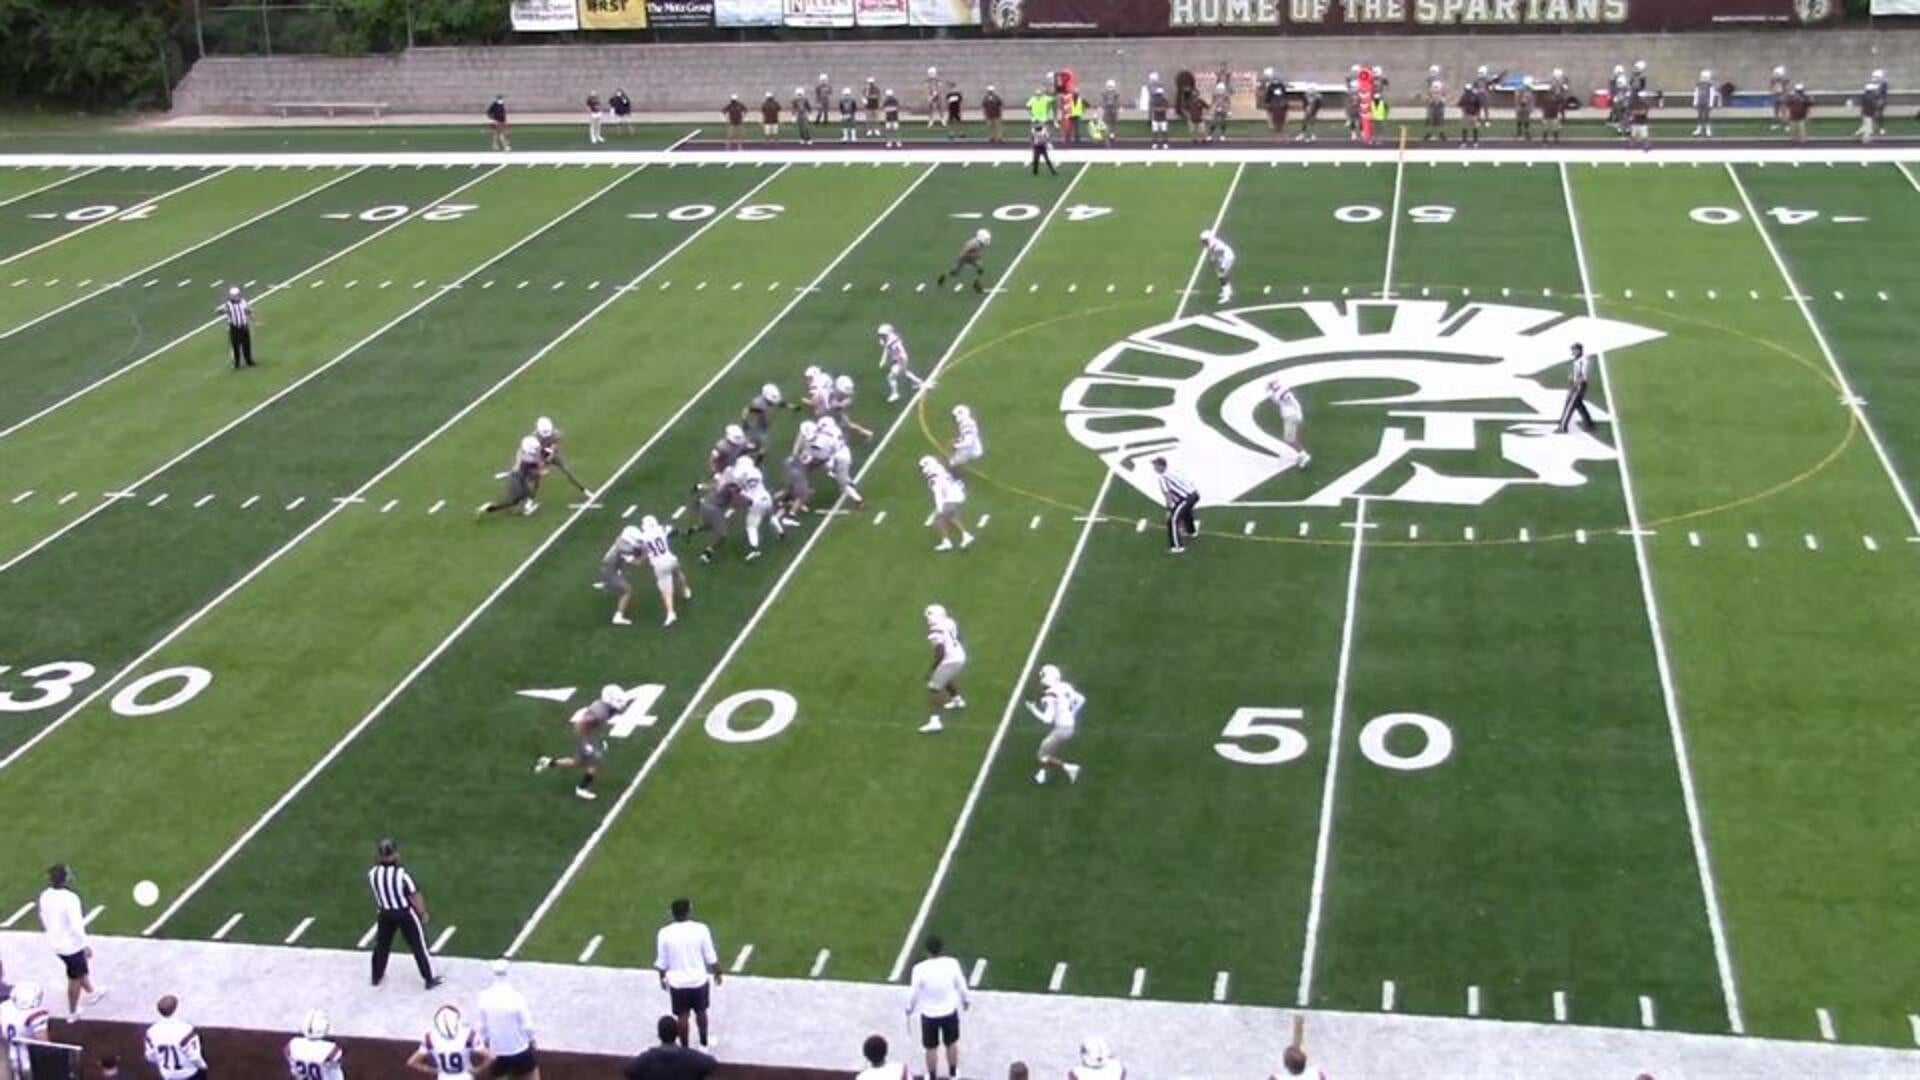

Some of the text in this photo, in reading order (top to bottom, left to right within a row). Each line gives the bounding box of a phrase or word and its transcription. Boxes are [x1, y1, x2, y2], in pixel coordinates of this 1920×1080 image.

[1169, 0, 1628, 26] HOME OF THE SPARTANS
[1214, 706, 1453, 770] 50
[158, 1045, 183, 1070] 71
[438, 1052, 464, 1074] 19
